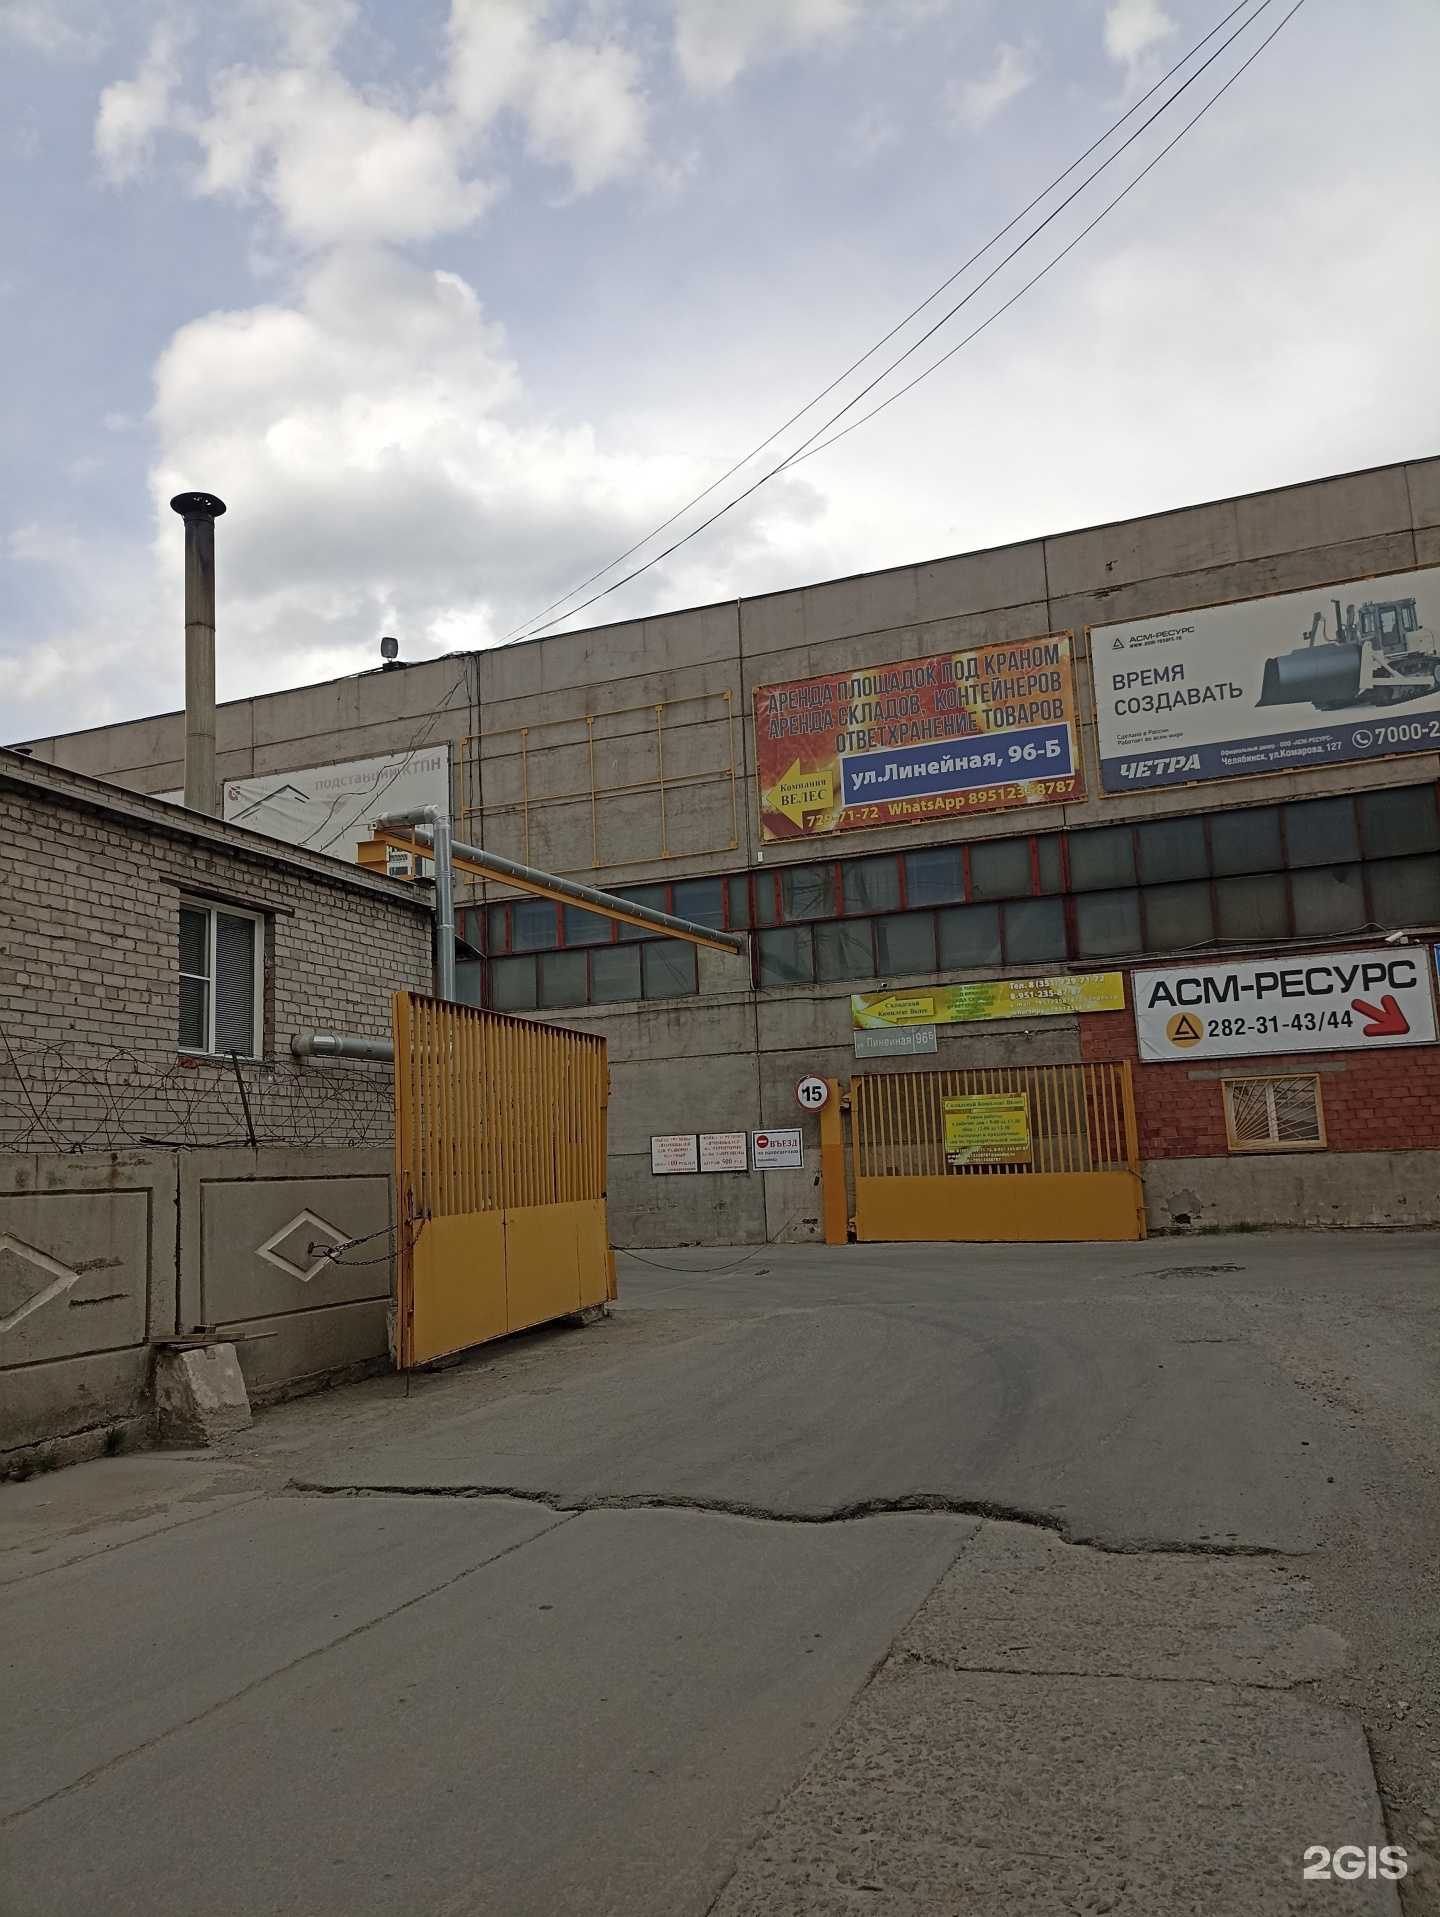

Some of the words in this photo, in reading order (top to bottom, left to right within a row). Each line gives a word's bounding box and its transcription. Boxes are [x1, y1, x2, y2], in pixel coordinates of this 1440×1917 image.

[1129, 626, 1195, 643] АСМ-РЕСУРС
[767, 686, 833, 715] АРЕНДА
[837, 666, 937, 701] ПЛОЩАДОК
[941, 658, 980, 683] ПОД
[984, 644, 1060, 675] КРАНОМ
[1112, 664, 1185, 691] ВРЕМЯ
[768, 711, 833, 740] АРЕНДА
[934, 671, 1062, 710] КОНТЕЙНЕРОВ
[1114, 681, 1244, 716] СОЗДАВАТЬ
[835, 712, 978, 753] ОТВЕТХРАНЕНИЕ
[982, 699, 1064, 729] ТОВАРОВ
[1326, 741, 1343, 752] 127
[851, 749, 1004, 791] ул.Линейная,
[1007, 738, 1061, 764] 96-Б
[1120, 753, 1201, 779] ЧЕТРА
[779, 778, 826, 792] Компания
[780, 788, 827, 807] ВЕЛЕС
[887, 795, 965, 818] WhatsApp
[1148, 959, 1417, 1009] АСМ-РЕСУРС
[1207, 1009, 1353, 1038] 282-31-43/44
[801, 1085, 823, 1102] 15
